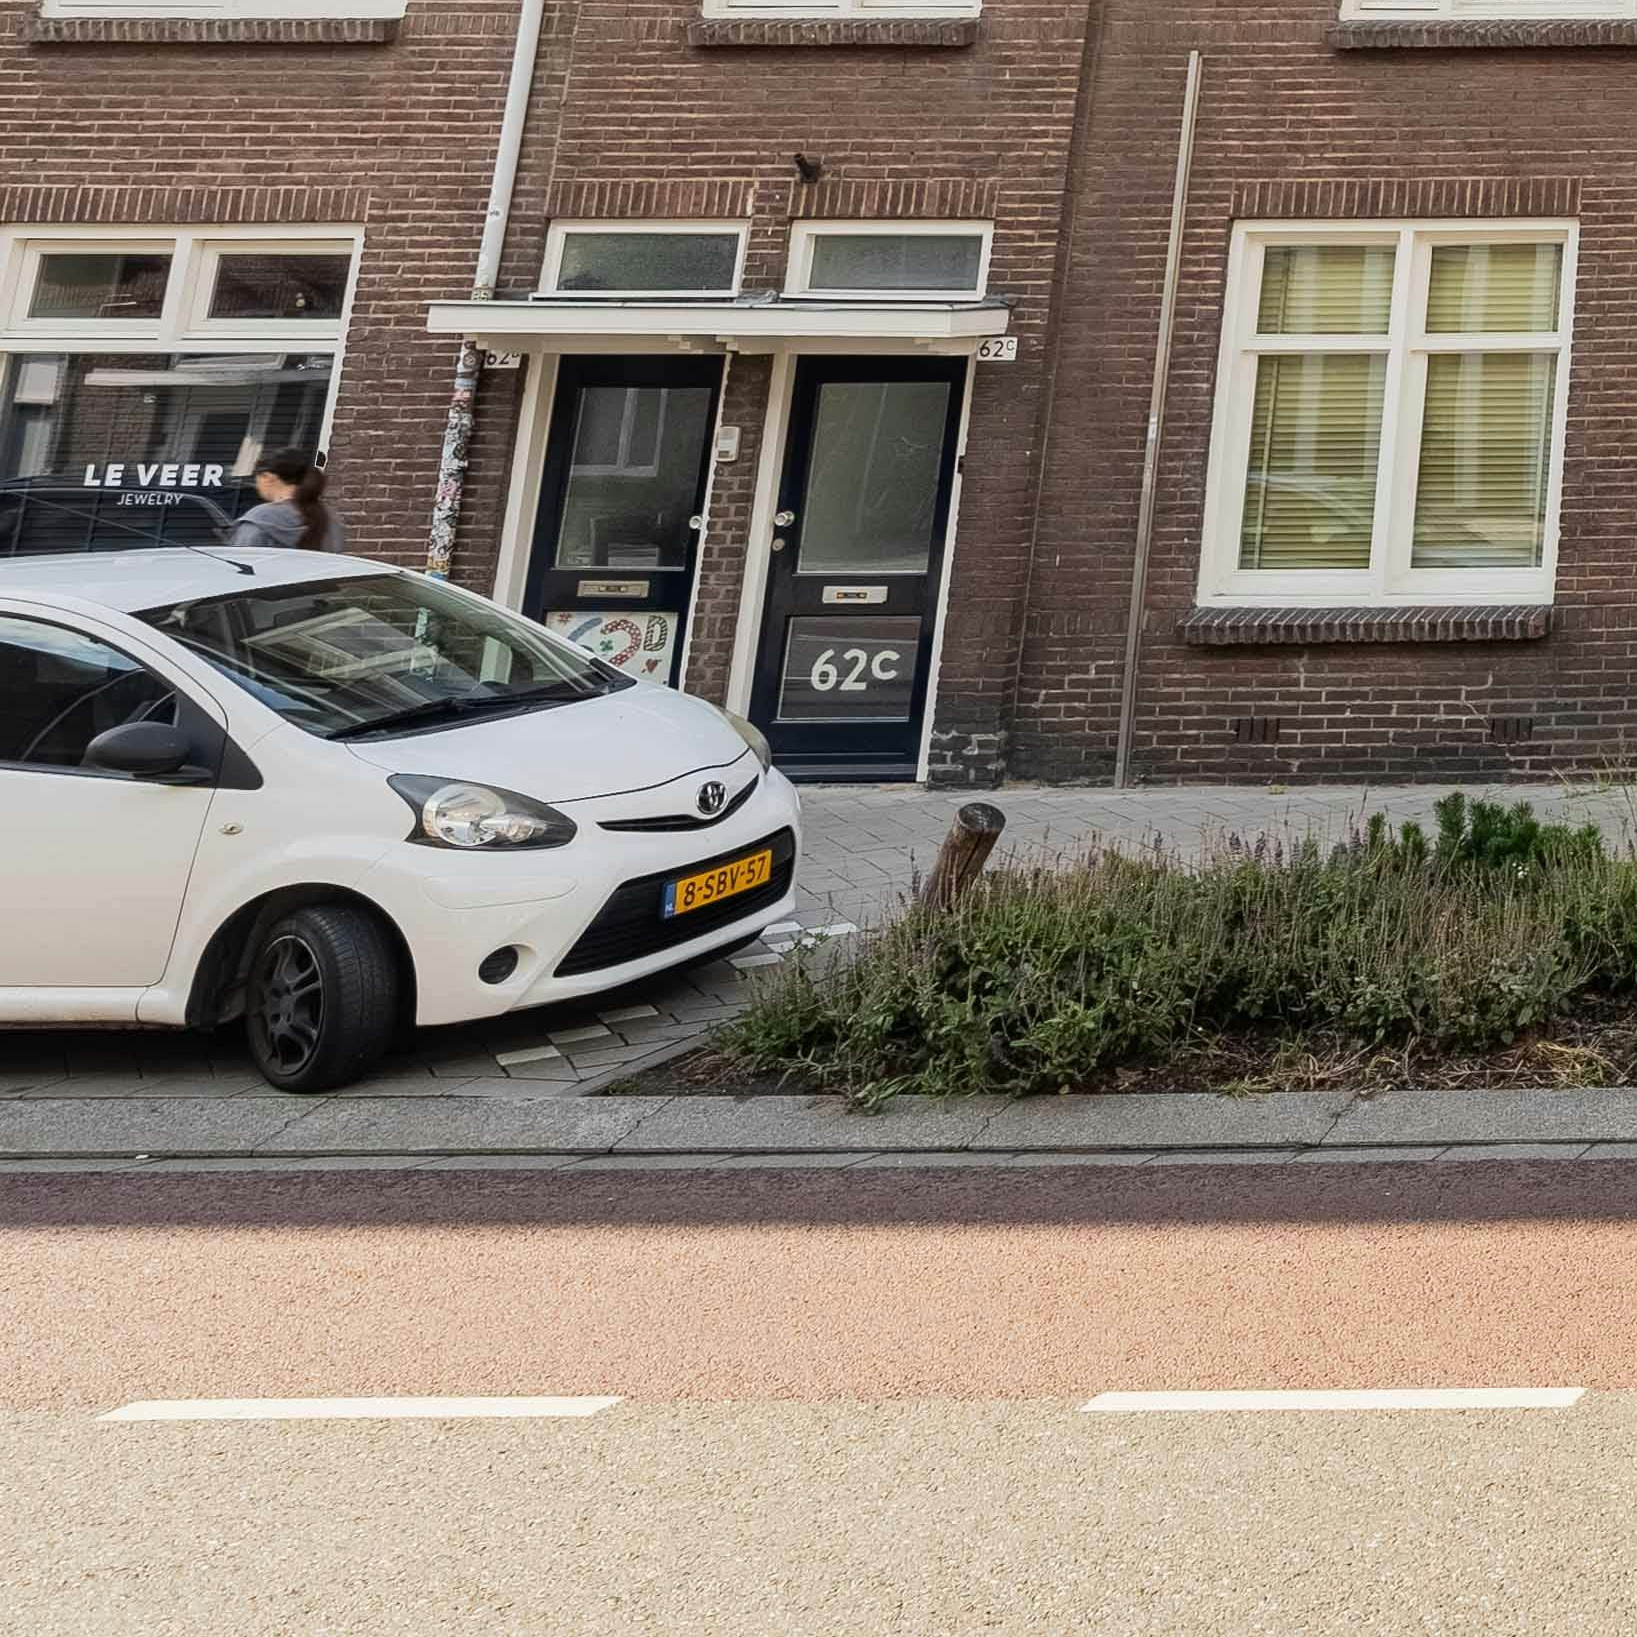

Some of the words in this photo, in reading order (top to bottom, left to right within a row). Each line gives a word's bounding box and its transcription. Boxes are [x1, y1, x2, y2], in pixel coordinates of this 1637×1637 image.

[979, 339, 1015, 357] 62C
[83, 463, 125, 487] LE
[136, 463, 224, 487] VEER
[116, 493, 184, 506] JEWELRY
[811, 648, 900, 692] 62C
[683, 854, 767, 908] 8-SBV-57
